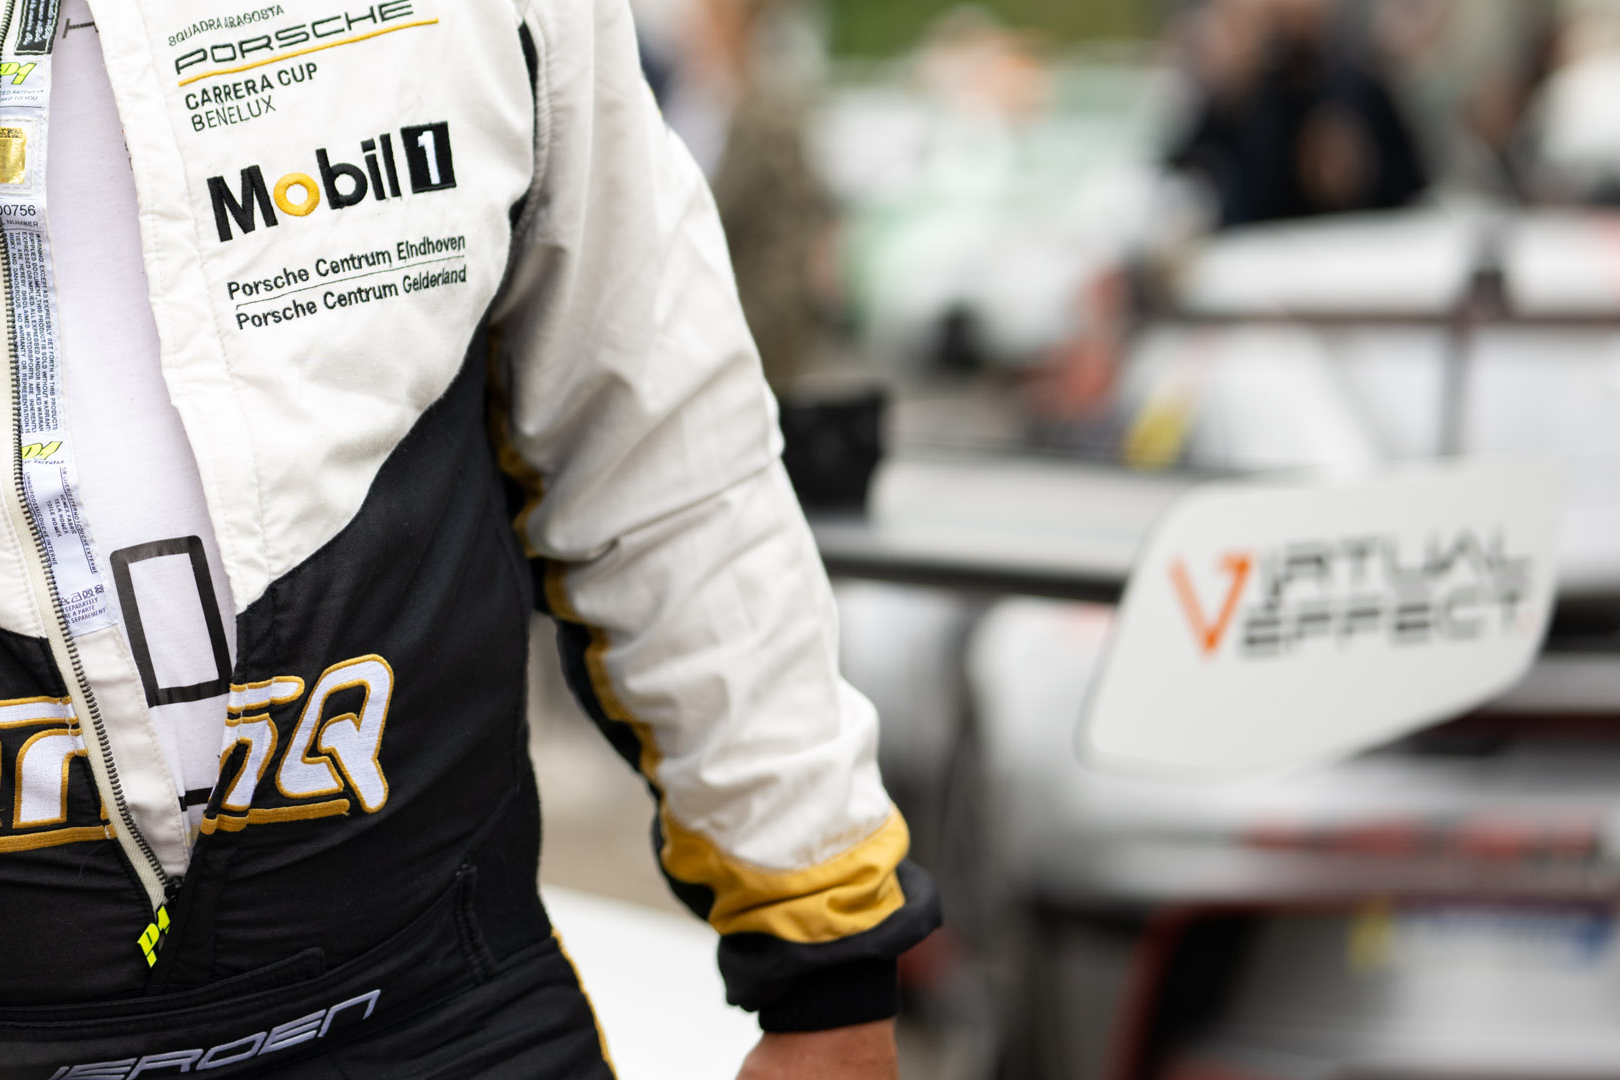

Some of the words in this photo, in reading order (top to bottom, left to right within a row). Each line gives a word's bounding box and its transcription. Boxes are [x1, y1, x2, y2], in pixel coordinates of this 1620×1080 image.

[168, 17, 224, 47] SQUADRA
[185, 74, 274, 110] CARRERA
[276, 62, 318, 87] CUP
[191, 95, 276, 132] BENELUX
[207, 133, 401, 242] Mobil
[227, 266, 310, 300] Porsche
[315, 248, 393, 277] Centrum
[397, 234, 466, 261] Eindhoven
[236, 298, 318, 331] Porsche
[323, 283, 399, 310] Centrum
[402, 264, 467, 294] Gelderland
